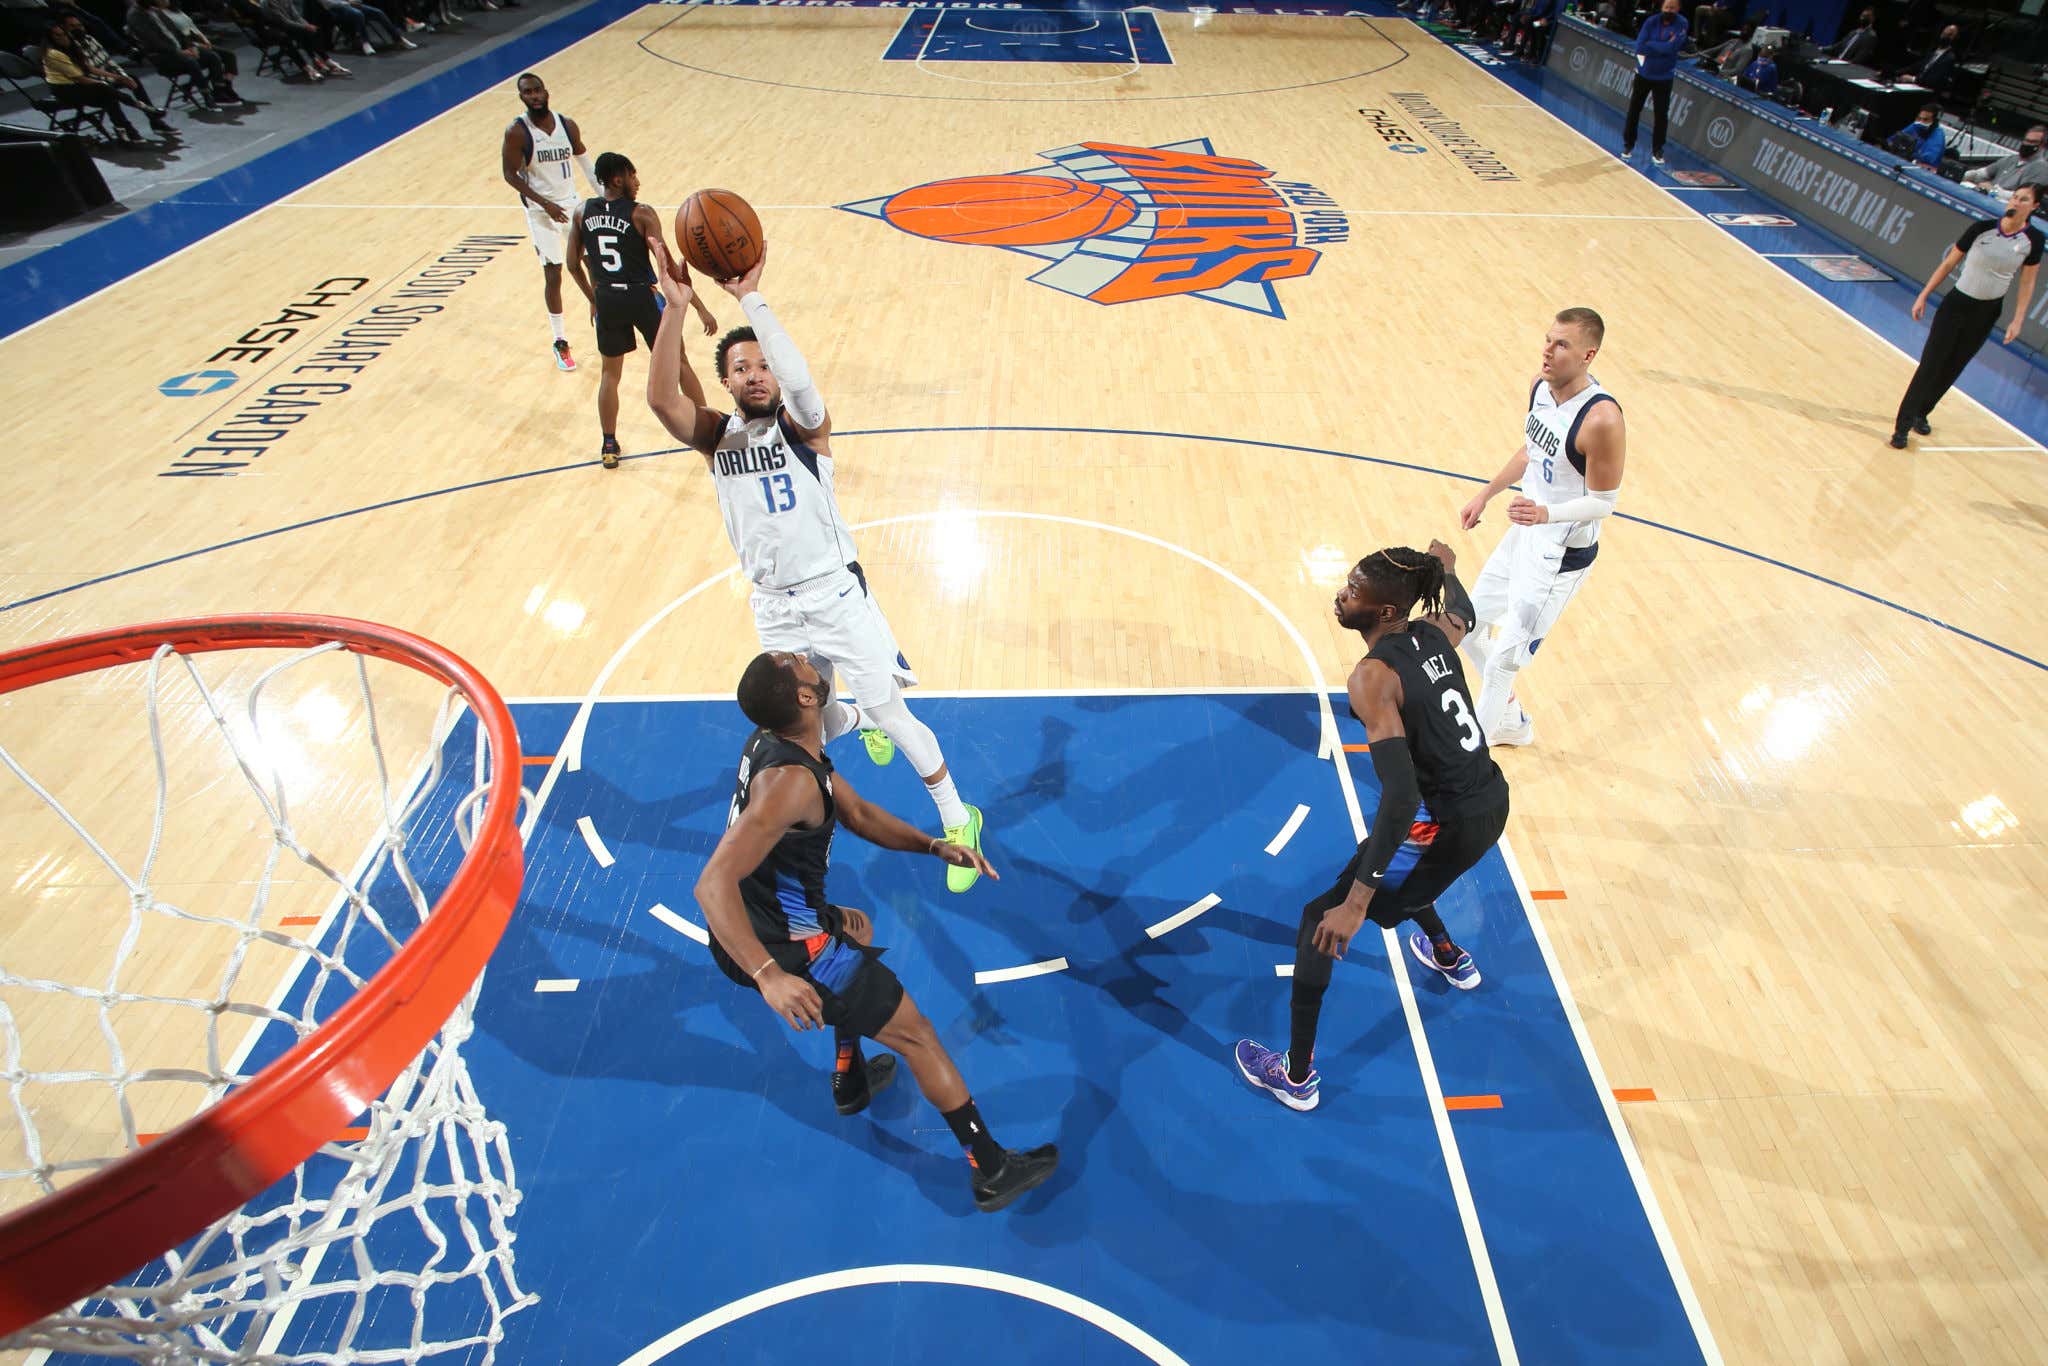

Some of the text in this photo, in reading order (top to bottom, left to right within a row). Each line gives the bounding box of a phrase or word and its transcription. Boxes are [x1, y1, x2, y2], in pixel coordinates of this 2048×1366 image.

[879, 1, 1023, 9] KNICKS
[1187, 6, 1374, 17] DELTA
[1358, 108, 1415, 143] CHASE
[1711, 120, 1731, 142] KIA
[537, 147, 571, 163] DALLAS
[1419, 120, 1482, 147] SQUARE
[1451, 149, 1521, 182] GARDEN
[560, 161, 572, 180] 11
[1752, 138, 1915, 245] THE FIRST-EVER KIA K5
[584, 215, 630, 234] QUICKLEY
[1079, 140, 1323, 305] KNICKS
[1272, 181, 1350, 245] NEW YORK
[597, 235, 623, 272] 5
[205, 276, 370, 364] CHASE
[157, 234, 528, 477] MADISON SQUARE GARDEN
[1526, 414, 1560, 457] DALLAS
[716, 442, 787, 477] DALLAS
[1543, 458, 1554, 484] 6
[759, 473, 797, 513] 13
[1441, 688, 1481, 752] 3
